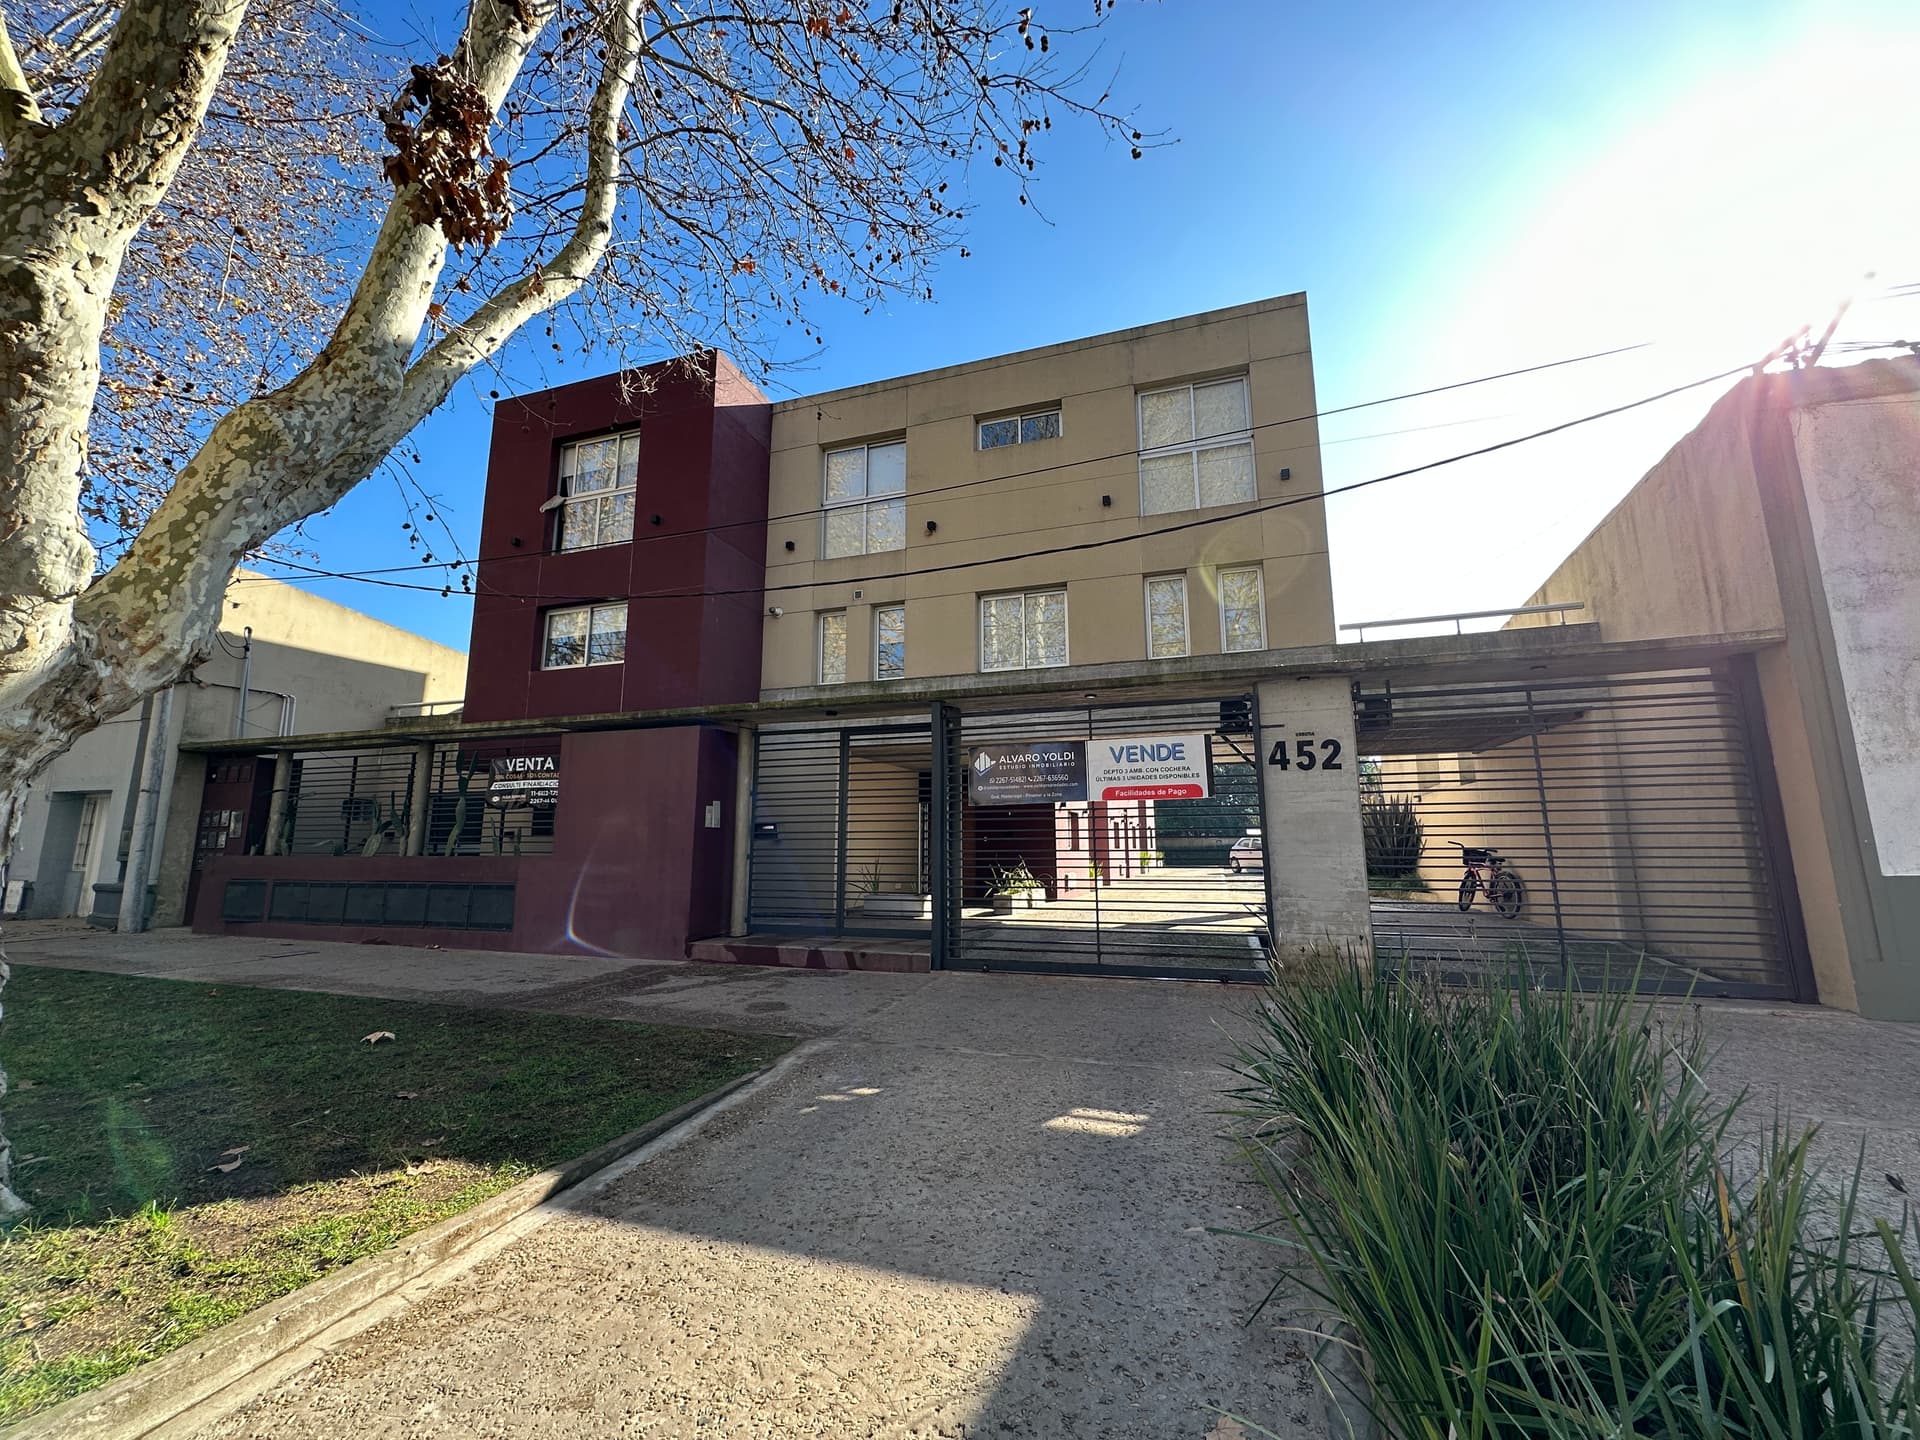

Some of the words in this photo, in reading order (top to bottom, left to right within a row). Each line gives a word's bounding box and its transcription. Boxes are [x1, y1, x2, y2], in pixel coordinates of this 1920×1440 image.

[1000, 753, 1040, 764] ALVARO
[1042, 751, 1075, 761] YOLDI
[1108, 742, 1186, 764] VENDE
[1268, 739, 1342, 771] 452
[506, 757, 555, 771] VENTA
[1160, 765, 1191, 773] COCHERA
[1158, 772, 1200, 780] DISPONIBLES
[1115, 789, 1156, 797] Facilidades
[1168, 787, 1187, 796] Pago
